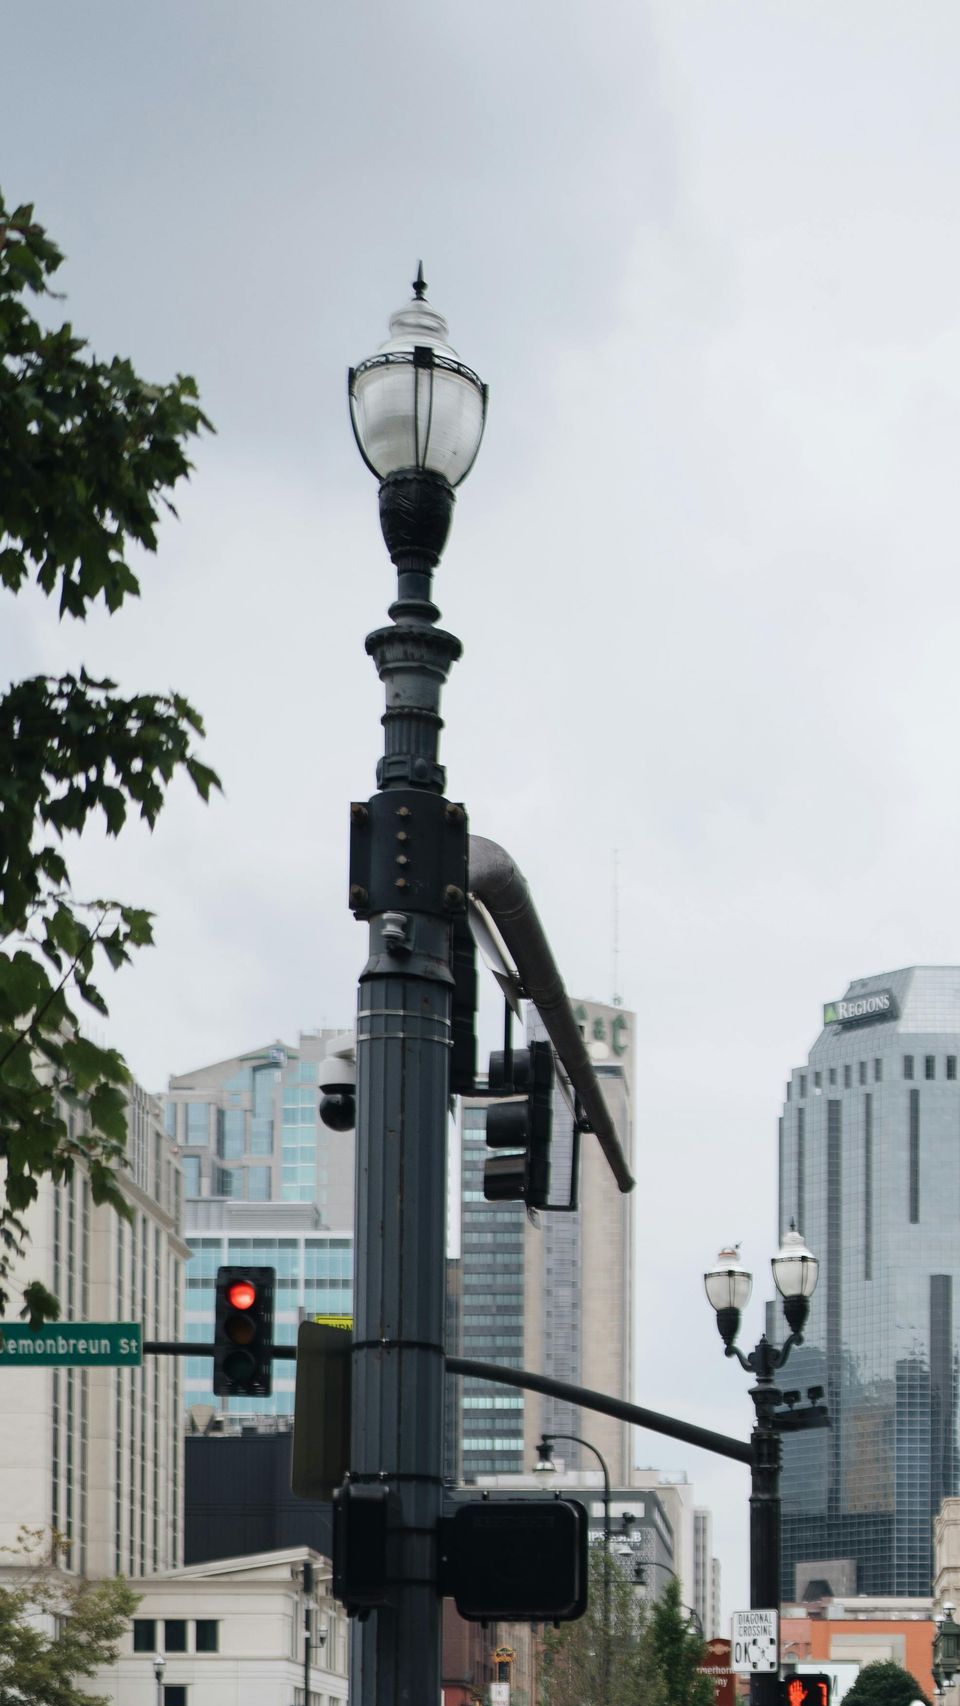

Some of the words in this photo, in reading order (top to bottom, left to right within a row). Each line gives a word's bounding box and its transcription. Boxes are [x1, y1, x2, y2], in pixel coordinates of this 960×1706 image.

[838, 994, 890, 1019] REGIONS
[119, 1337, 138, 1354] St
[738, 1614, 773, 1625] DIAGONAL
[738, 1625, 773, 1637] CROSSING
[735, 1642, 751, 1664] OK
